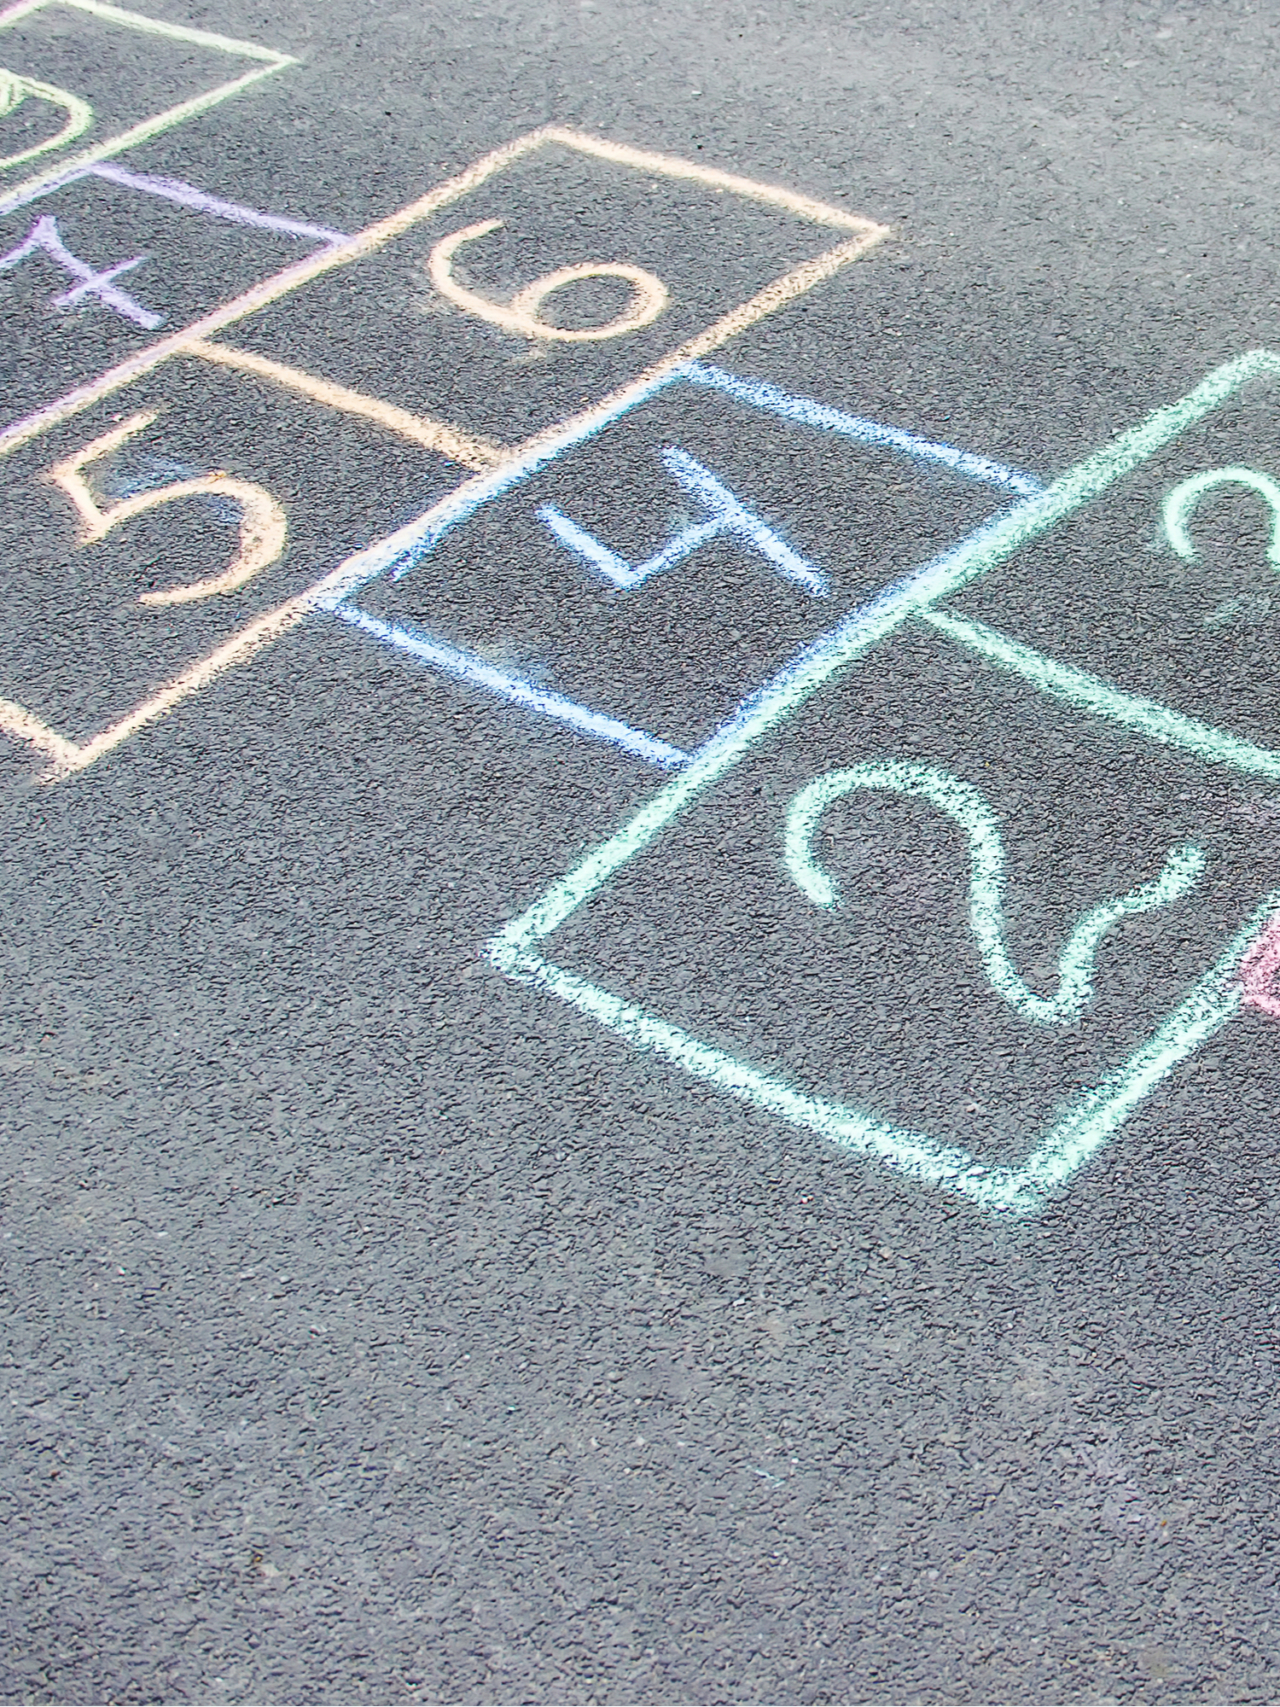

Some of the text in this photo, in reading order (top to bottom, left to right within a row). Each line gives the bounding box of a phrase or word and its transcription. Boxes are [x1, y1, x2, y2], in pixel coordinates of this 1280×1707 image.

[428, 219, 668, 341] 6
[52, 410, 287, 607] 5
[537, 447, 831, 596] 4
[784, 760, 1206, 1025] 2
